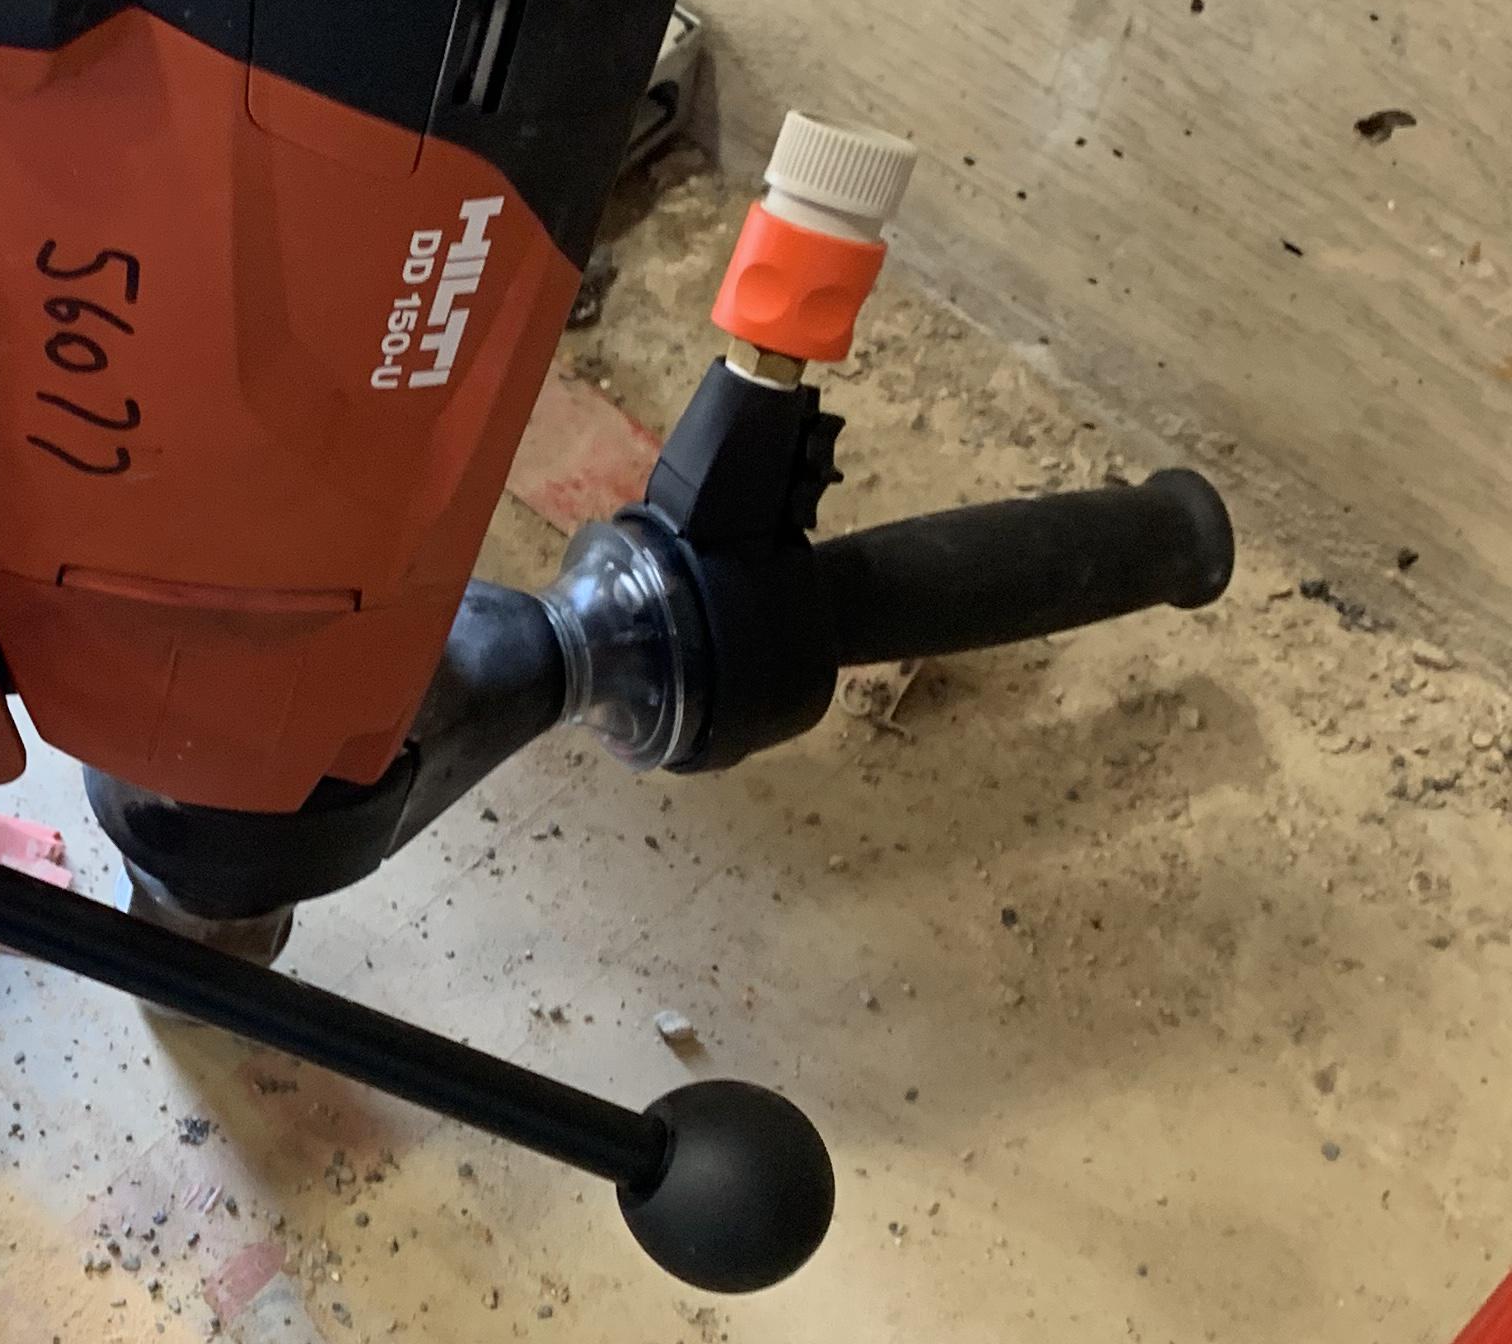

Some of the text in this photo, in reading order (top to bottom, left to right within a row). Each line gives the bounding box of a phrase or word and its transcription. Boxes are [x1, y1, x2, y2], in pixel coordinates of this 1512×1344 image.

[27, 240, 141, 475] 56077
[370, 229, 443, 389] DD 150-U
[408, 195, 505, 389] HILTI
